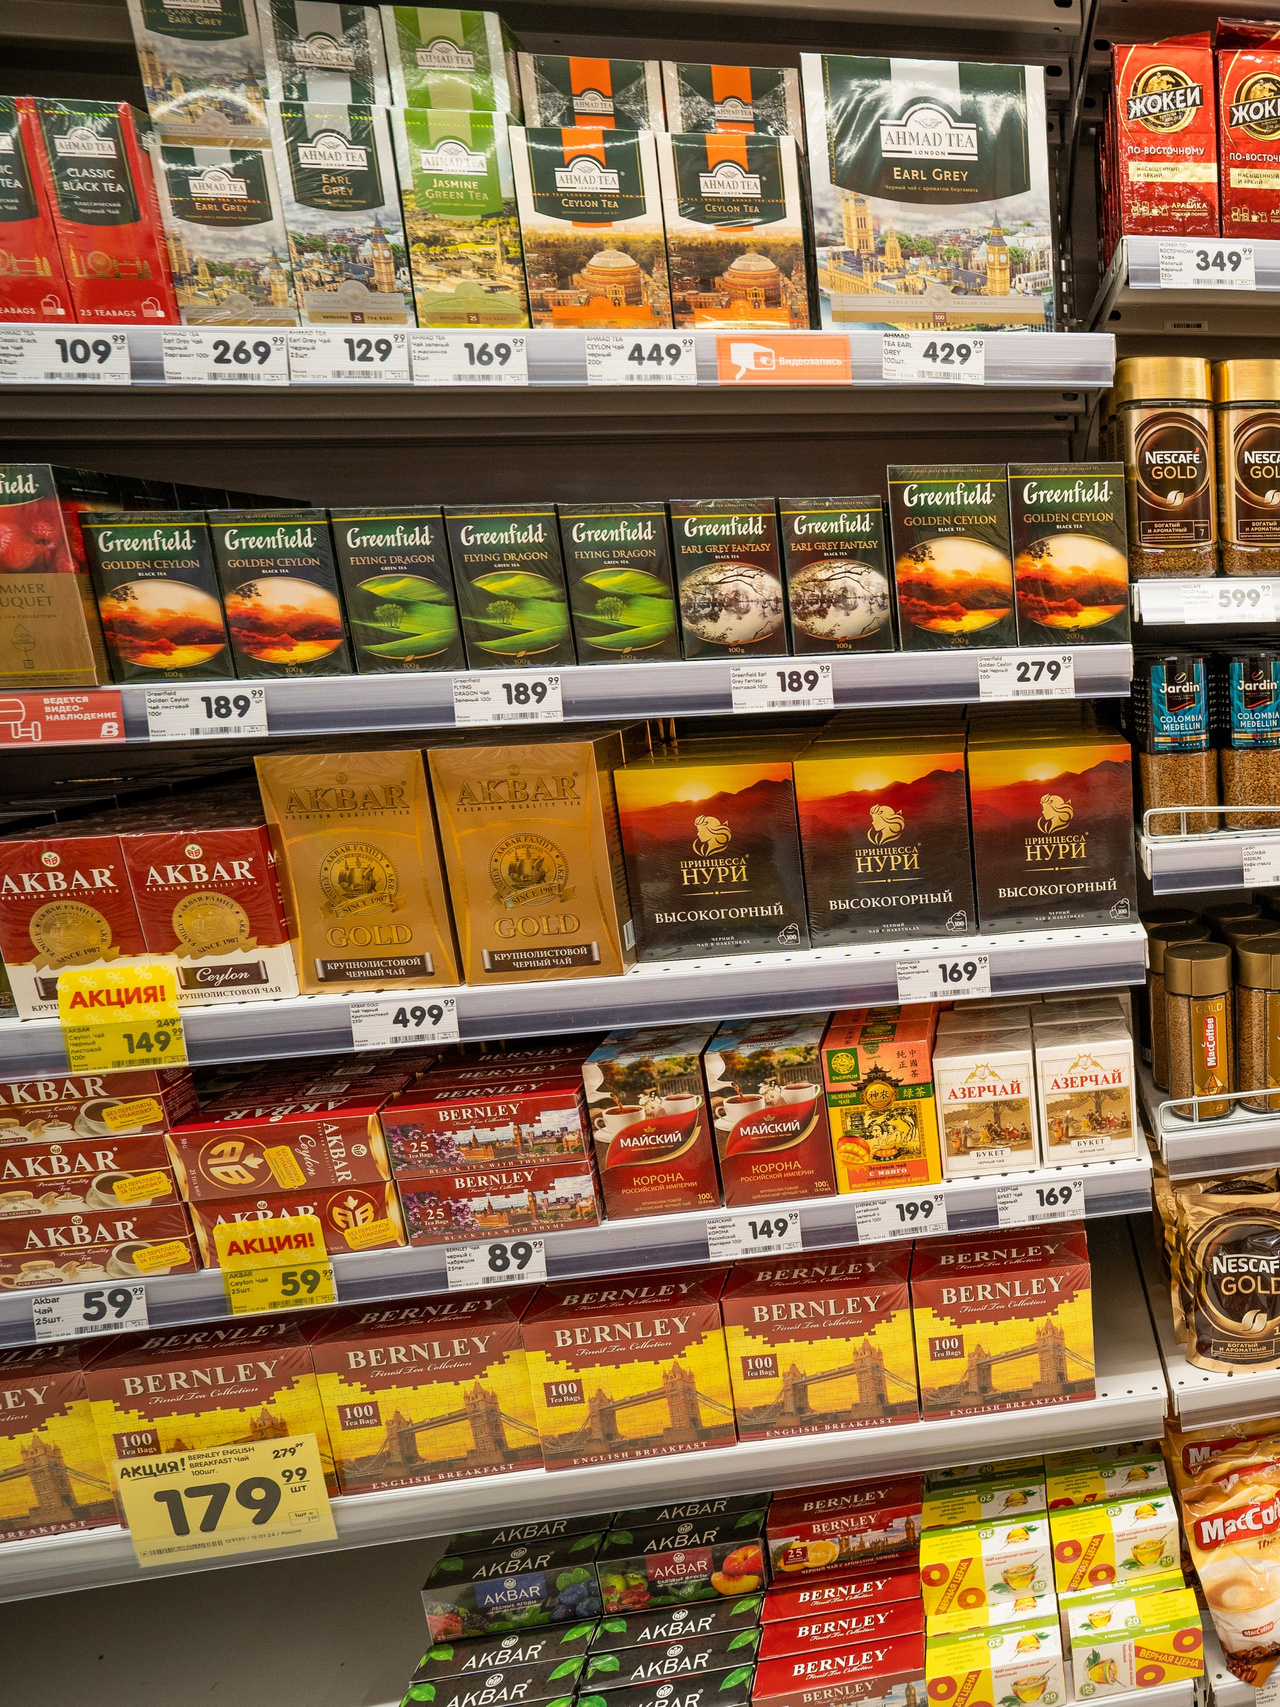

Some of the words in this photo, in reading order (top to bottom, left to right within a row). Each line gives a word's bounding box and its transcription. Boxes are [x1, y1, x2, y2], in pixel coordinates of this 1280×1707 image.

[883, 130, 942, 148] AHMAD
[944, 131, 976, 149] TEA
[66, 167, 115, 180] CLASSIC
[63, 181, 97, 193] BLACK
[101, 182, 125, 193] TEA
[94, 308, 136, 318] TEABAGS
[55, 339, 111, 364] 109
[112, 335, 126, 343] 99
[627, 343, 681, 366] 449
[922, 342, 971, 365] 429
[779, 356, 842, 368] Видеозапись
[1145, 447, 1201, 465] NESCAFÉ
[1151, 464, 1198, 481] GOLD
[98, 528, 193, 553] Greenfield
[681, 544, 701, 554] EARL
[703, 544, 726, 554] GREY
[729, 543, 771, 553] FANTASY
[102, 560, 150, 571] GOLDEN
[153, 559, 200, 570] CEYLON
[350, 554, 386, 566] FLYING
[389, 554, 435, 565] DRAGON
[1016, 660, 1061, 682] 279
[1159, 679, 1200, 694] Jardin
[43, 696, 88, 704] ВЕДЕТСЯ
[200, 694, 250, 719] 189
[251, 689, 263, 697] 99
[46, 712, 117, 721] НАБЛЮДЕНИЕ
[1236, 711, 1280, 722] COLOMBIA
[1239, 720, 1278, 729] MEDELLIN
[680, 858, 746, 870] ПРИНЦЕССА
[146, 860, 250, 887] AKBAR
[681, 865, 748, 887] НУРИ
[654, 904, 784, 924] ВЫСОКОГОРНЫЙ
[326, 956, 421, 972] КРУПНОЛИСТОВОЙ
[345, 967, 381, 978] ЧЕРНЫЙ
[384, 965, 405, 976] ЧАЙ
[195, 964, 250, 986] Ceylon
[70, 985, 167, 1009] АКЦИЯ!
[1204, 1015, 1218, 1068] MacCoffee
[947, 1081, 1022, 1101] АЗЕРЧАЙ
[439, 1104, 520, 1123] BERNLEY
[620, 1131, 682, 1148] МАЙСКИЙ
[976, 1149, 1005, 1158] БУКЕТ
[633, 1173, 684, 1186] КОРОНА
[621, 1185, 664, 1195] РОССИЙСКОЙ
[666, 1181, 697, 1190] ИМПЕРИИ
[488, 1243, 533, 1273] 89
[941, 1276, 1065, 1305] BERNLEY
[32, 1297, 60, 1306] Akbar
[82, 1288, 133, 1322] 59
[34, 1307, 53, 1315] Чай
[35, 1317, 64, 1326] 25шт.
[934, 1338, 958, 1351] 100
[950, 1405, 1000, 1416] ENGLISH
[1006, 1395, 1071, 1409] BREAKFAST
[187, 1452, 220, 1461] BERNLEY
[222, 1447, 255, 1456] ENGLISH
[120, 1457, 186, 1480] АКЦИЯ!
[190, 1457, 232, 1469] BREAKFAST
[235, 1456, 249, 1464] Чай
[191, 1469, 218, 1477] 100шт.
[154, 1476, 281, 1537] 179
[281, 1467, 307, 1483] 99
[1256, 1538, 1276, 1551] The
[483, 1585, 540, 1605] AKBAR
[1138, 1649, 1174, 1665] ВЕРНАЯ
[1174, 1657, 1200, 1667] ЦЕНА
